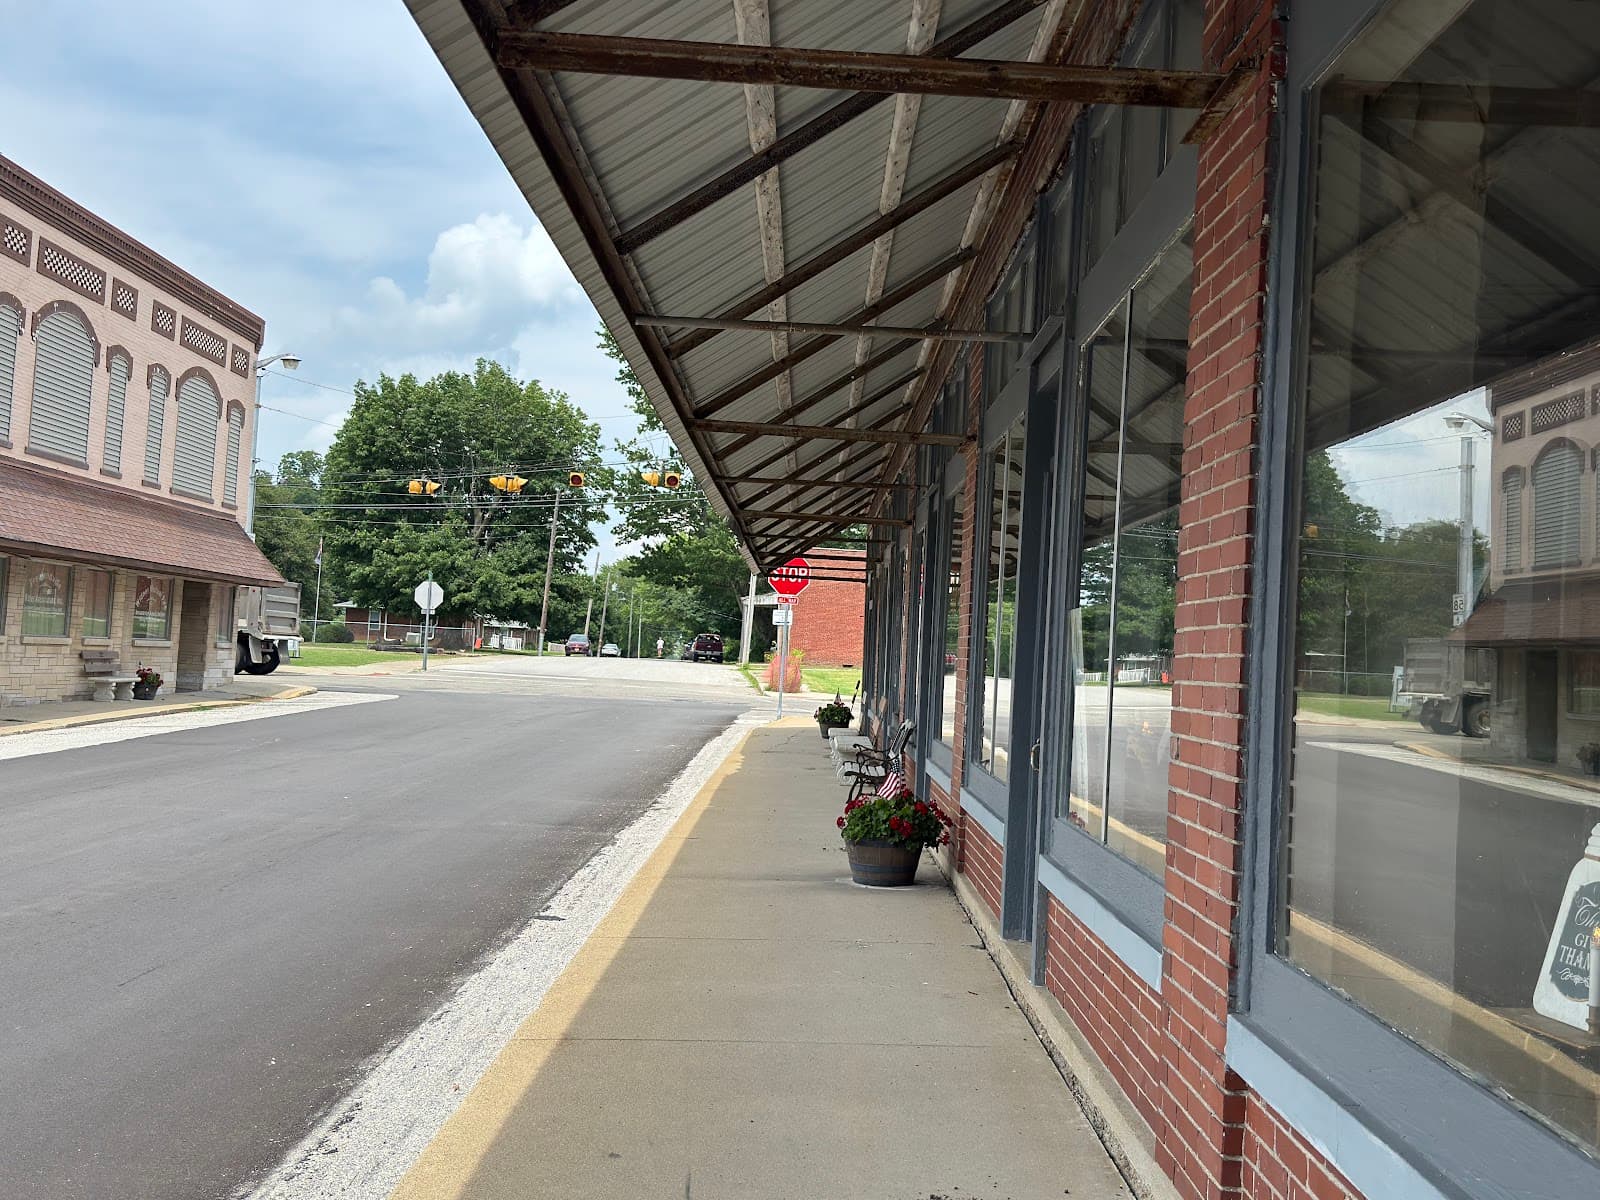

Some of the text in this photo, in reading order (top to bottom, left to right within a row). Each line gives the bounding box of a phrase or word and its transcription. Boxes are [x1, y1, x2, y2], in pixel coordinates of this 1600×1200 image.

[771, 567, 808, 582] STOP
[1574, 932, 1590, 949] GI
[1559, 944, 1590, 971] THAN
